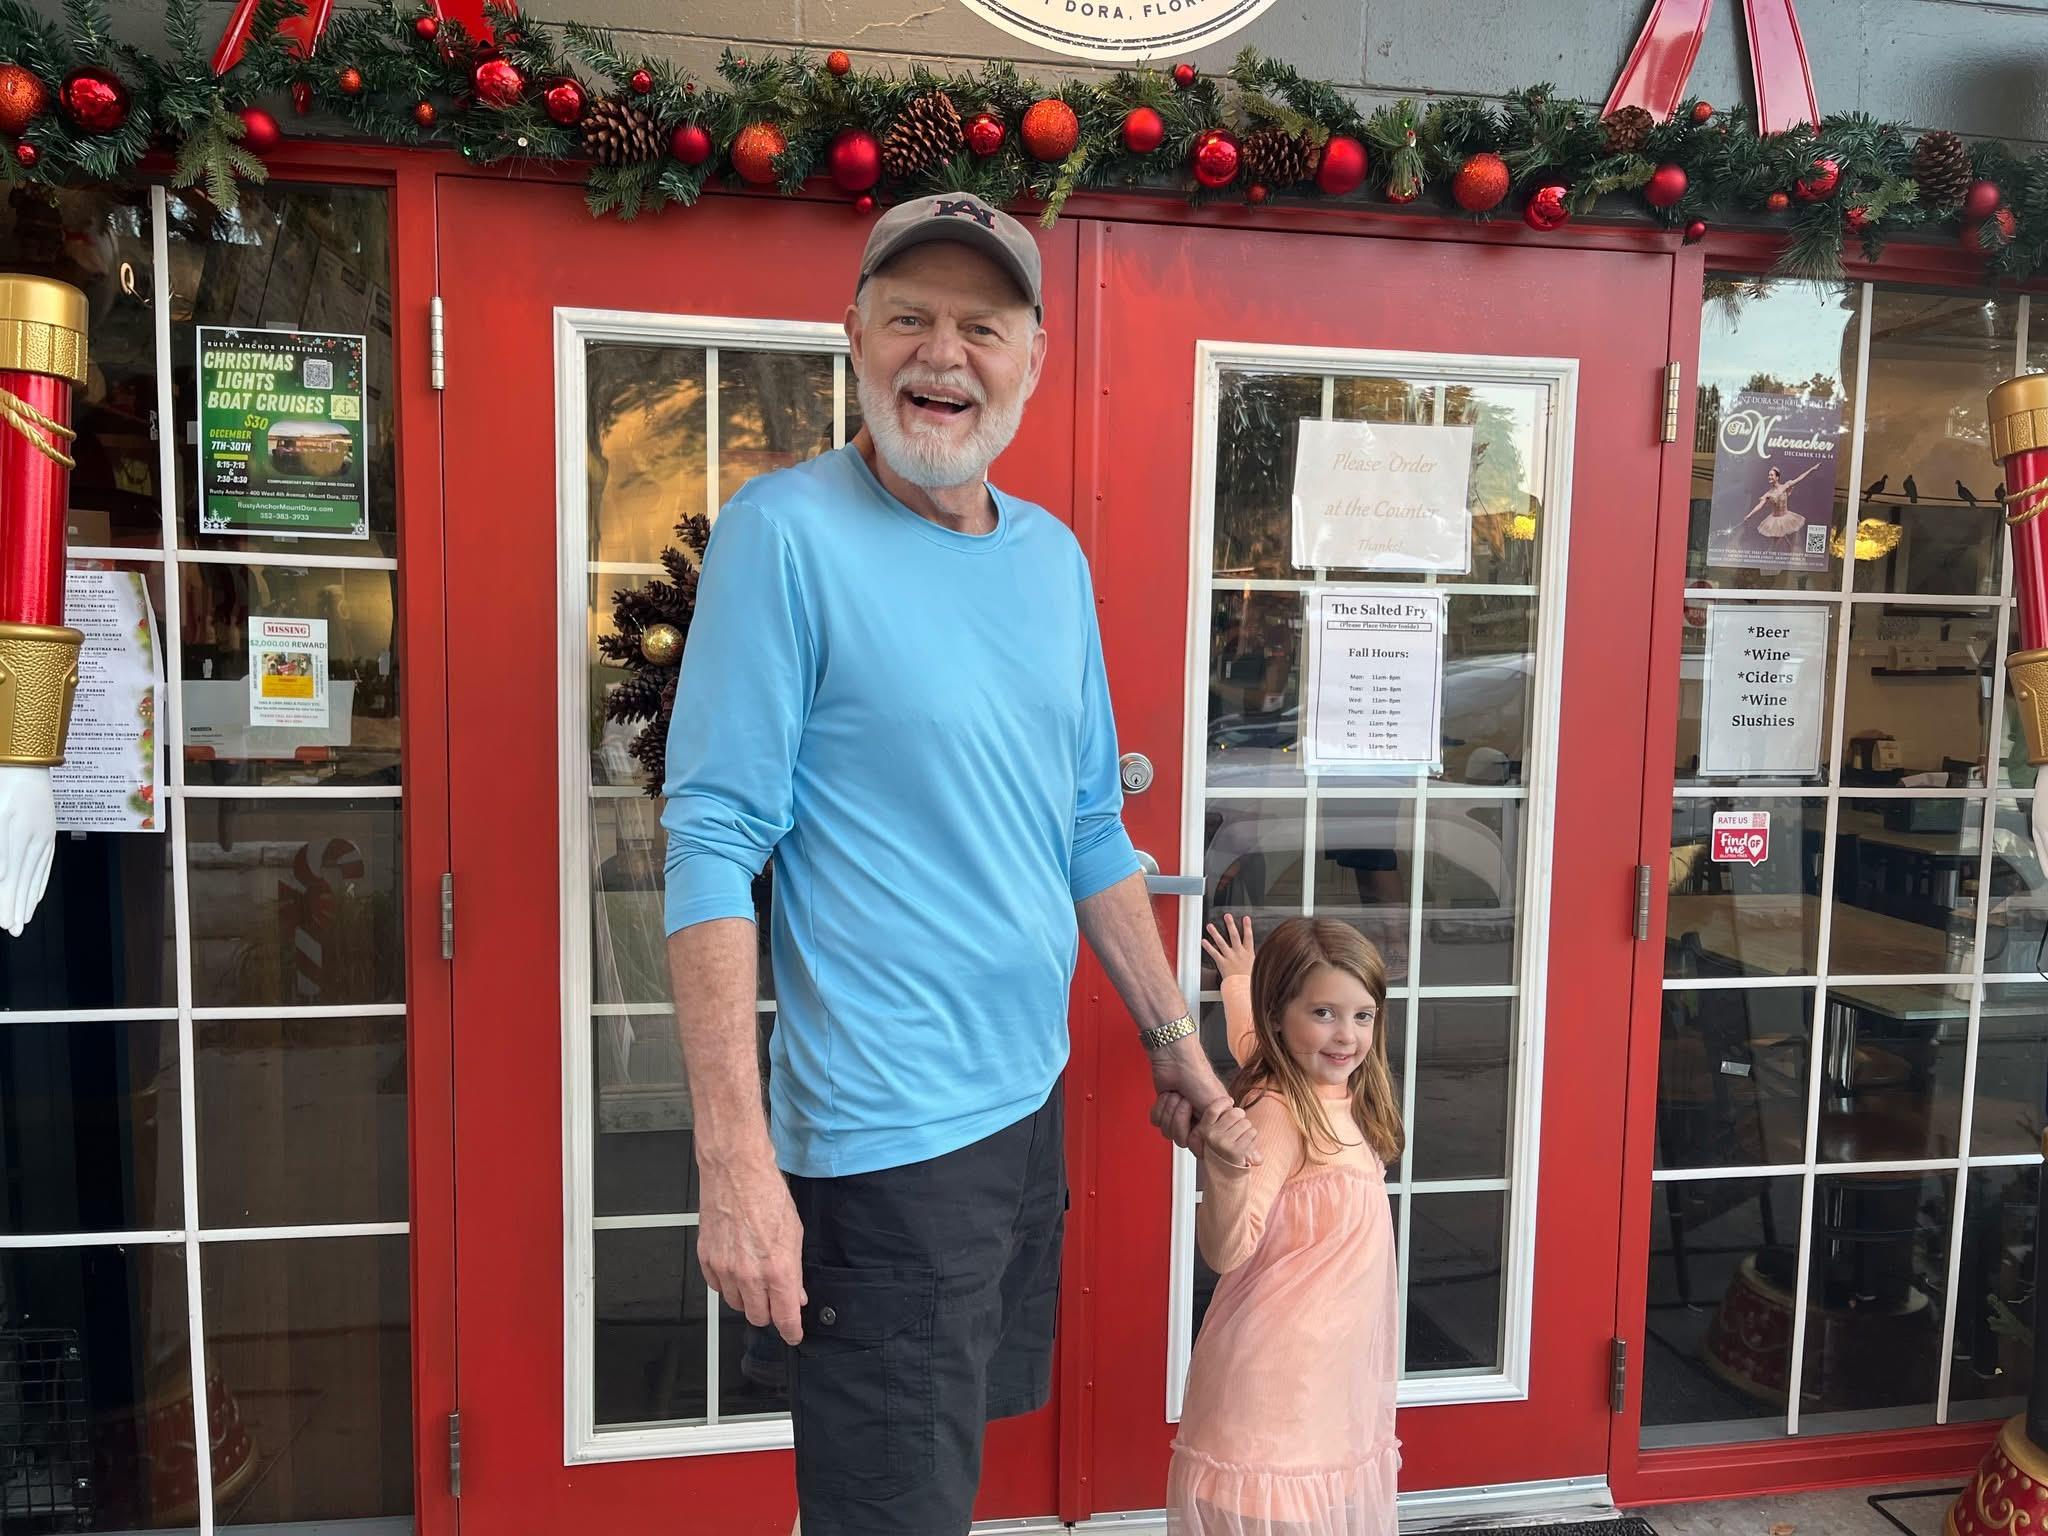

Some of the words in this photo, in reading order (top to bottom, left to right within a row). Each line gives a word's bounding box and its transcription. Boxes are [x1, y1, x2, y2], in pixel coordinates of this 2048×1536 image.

[203, 351, 294, 371] CHRISTMAS
[216, 371, 275, 391] LIGHTS
[207, 392, 253, 410] BOAT
[256, 394, 325, 414] CRUISES
[244, 414, 269, 430] $30
[209, 429, 252, 439] DECEMBER
[1720, 409, 1835, 459] Nutcracker
[211, 441, 252, 452] 7TH-30TH
[1784, 450, 1813, 458] DECEMBER
[1333, 451, 1382, 472] Please
[1389, 454, 1438, 473] Order
[237, 501, 333, 513] RustyAnchorMountDora.com
[1324, 501, 1341, 517] at
[1344, 497, 1370, 517] the
[1332, 603, 1357, 615] The
[1360, 604, 1401, 616] Salted
[1405, 605, 1427, 619] Fry
[267, 625, 307, 635] MISSING
[1349, 647, 1369, 658] Fall
[1371, 648, 1409, 659] Hours:
[1731, 714, 1795, 728] Slushies
[1718, 816, 1737, 824] RATE
[1724, 846, 1745, 854] me
[1750, 839, 1761, 848] GF
